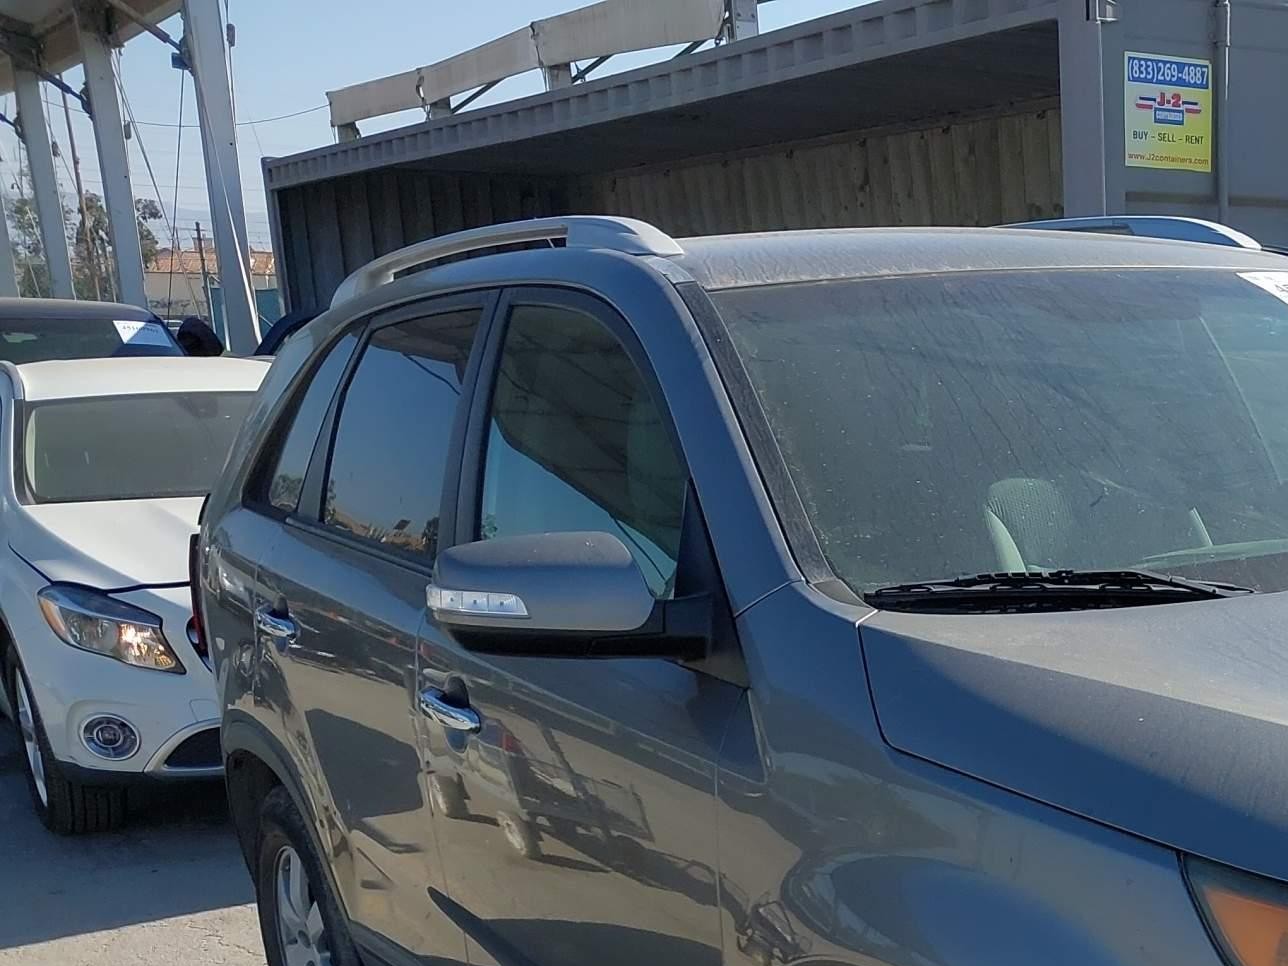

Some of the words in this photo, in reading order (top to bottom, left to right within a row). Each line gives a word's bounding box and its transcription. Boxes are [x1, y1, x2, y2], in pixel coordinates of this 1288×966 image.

[1128, 59, 1208, 85] (833)269-4887
[1157, 92, 1181, 108] J-2
[1133, 130, 1149, 140] BUY
[1157, 132, 1176, 143] SELL
[1185, 135, 1204, 145] RENT
